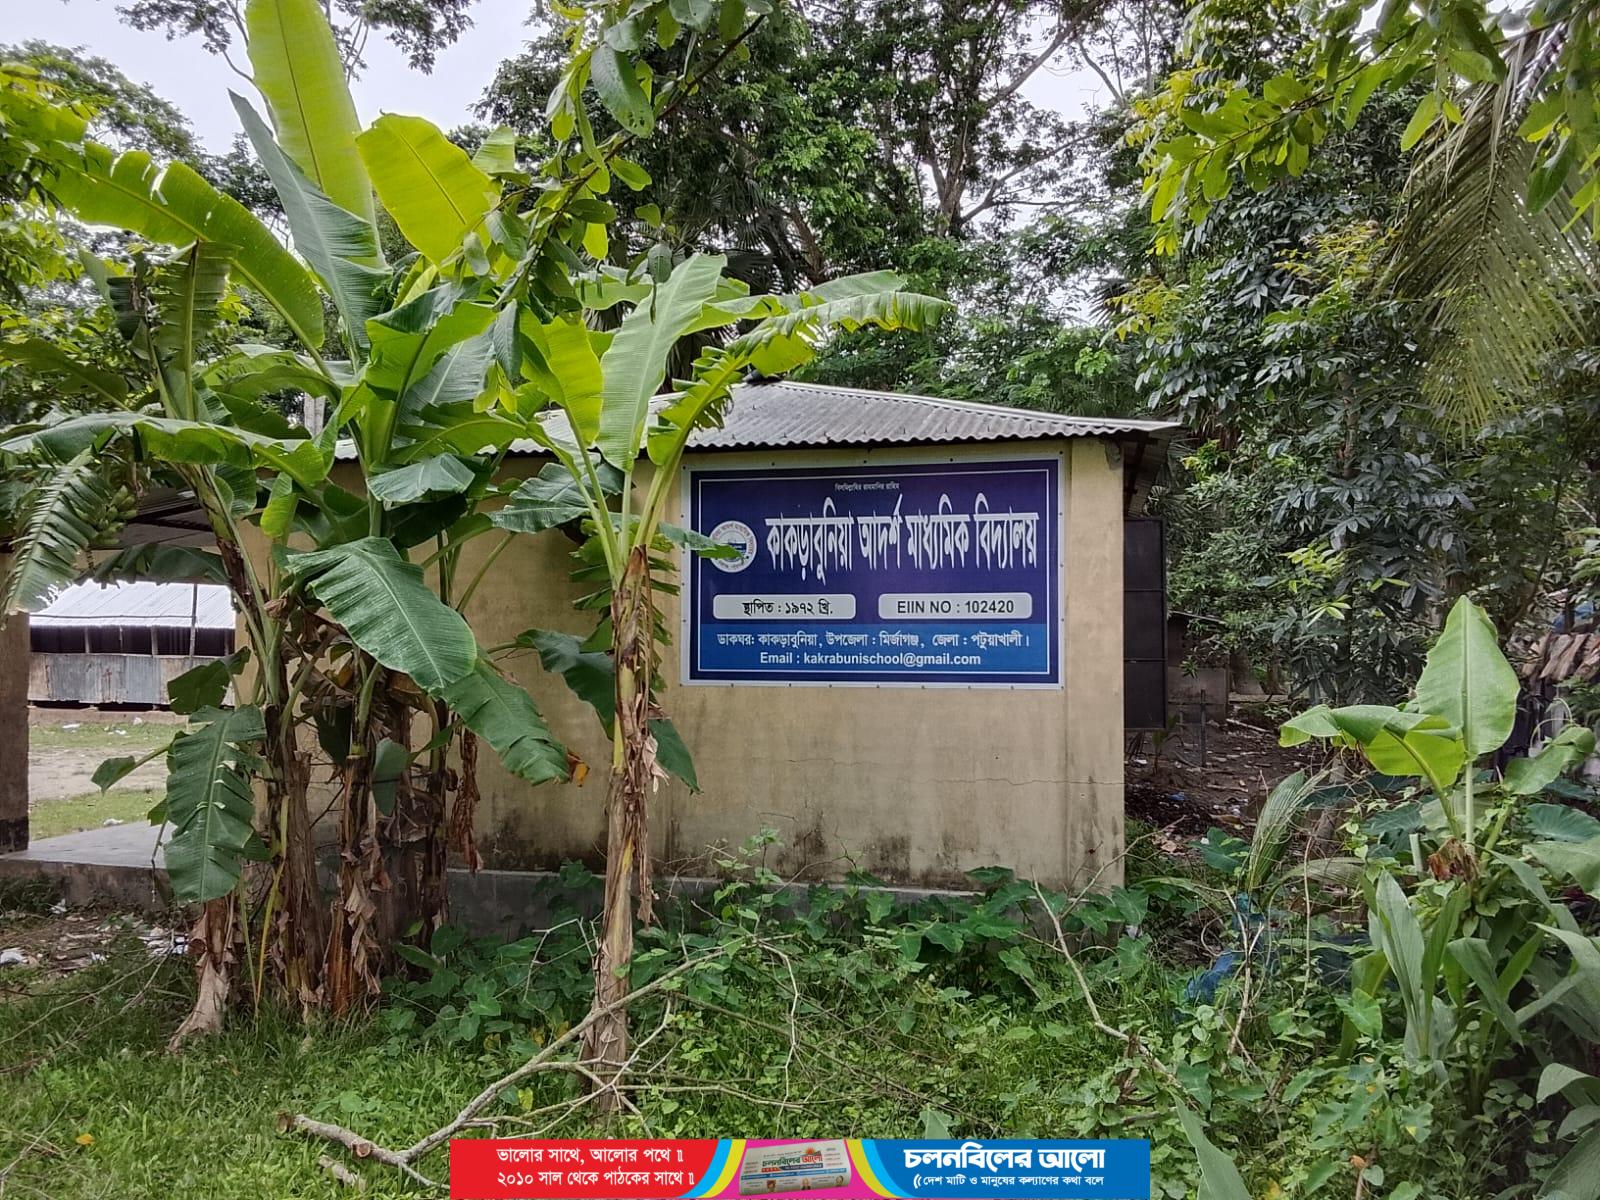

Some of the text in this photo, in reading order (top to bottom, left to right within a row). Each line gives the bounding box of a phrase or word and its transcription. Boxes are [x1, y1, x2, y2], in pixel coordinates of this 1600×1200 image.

[765, 497, 854, 586] কাকড়াবুনিয়া
[857, 493, 903, 570] আদর্শ
[905, 493, 970, 570] মাধ্যমিক
[973, 493, 1039, 570] বিদ্যালয়
[742, 598, 774, 616] স্থাপিত
[785, 602, 814, 615] ১৯৭২
[897, 600, 925, 614] EIIN
[930, 600, 952, 614] NO
[965, 600, 1014, 614] 102420
[825, 631, 868, 646] উপজেলা
[932, 633, 960, 646] জেলা
[760, 652, 793, 664] Email
[804, 652, 981, 667] kakrabunischool@gmail.com
